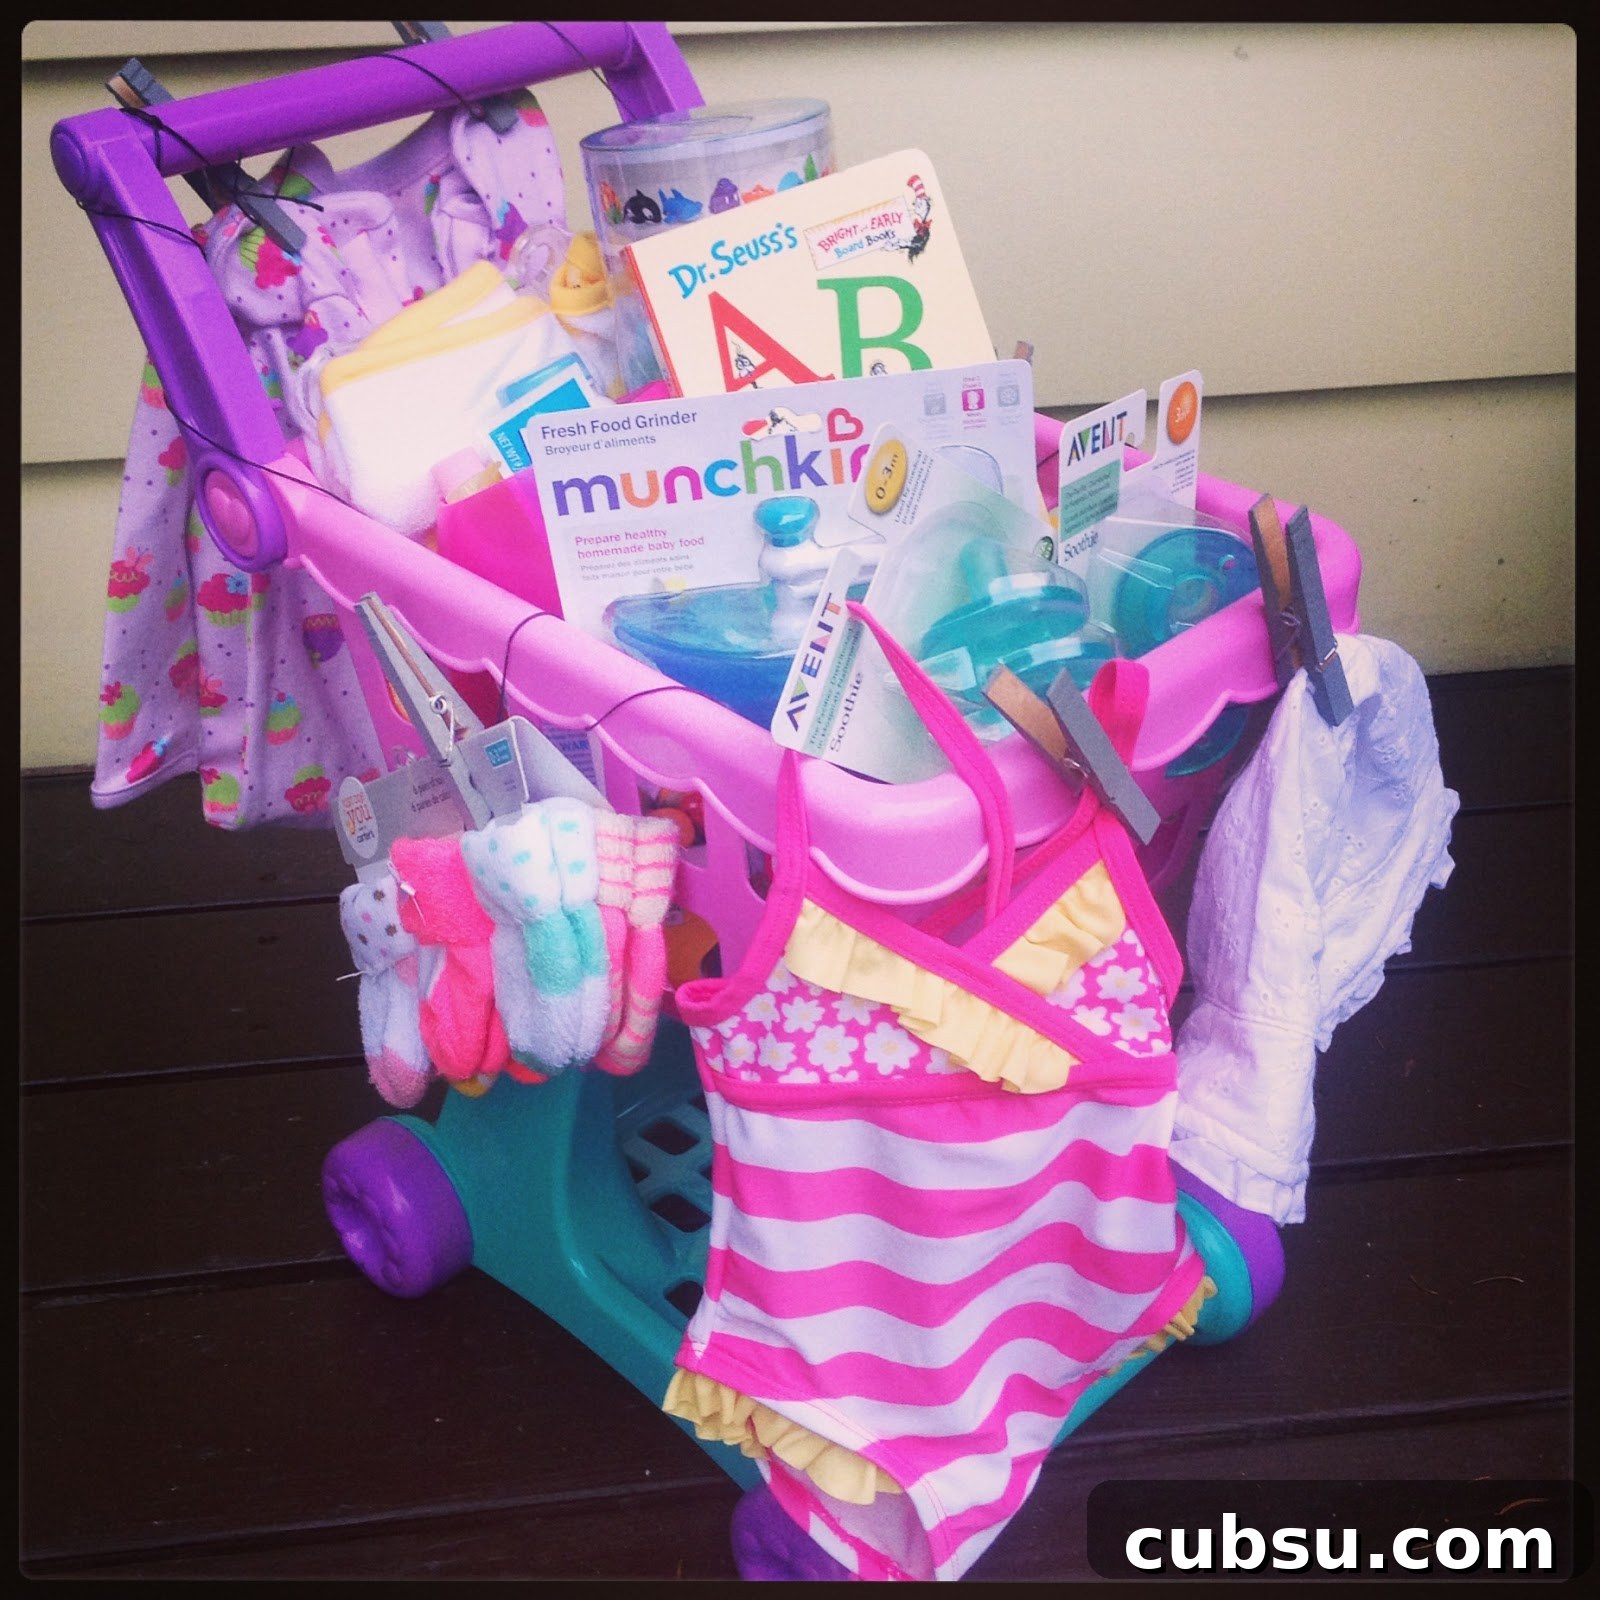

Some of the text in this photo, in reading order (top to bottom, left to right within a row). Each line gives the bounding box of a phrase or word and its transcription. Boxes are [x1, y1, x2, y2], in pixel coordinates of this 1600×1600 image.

[817, 211, 903, 252] BRIGHT EARLY
[834, 229, 896, 258] Board Books
[668, 222, 798, 299] Dr. Seuss's
[541, 411, 698, 440] Fresh Food Grinder
[1067, 411, 1127, 466] AVENT
[545, 435, 657, 456] Broyeur d'aliments
[875, 453, 898, 499] 0-3m
[575, 528, 667, 546] Prepare healthy
[577, 536, 705, 560] homemade baby food
[786, 592, 841, 733] AVENT
[829, 672, 864, 752] Soothie
[346, 803, 372, 835] you
